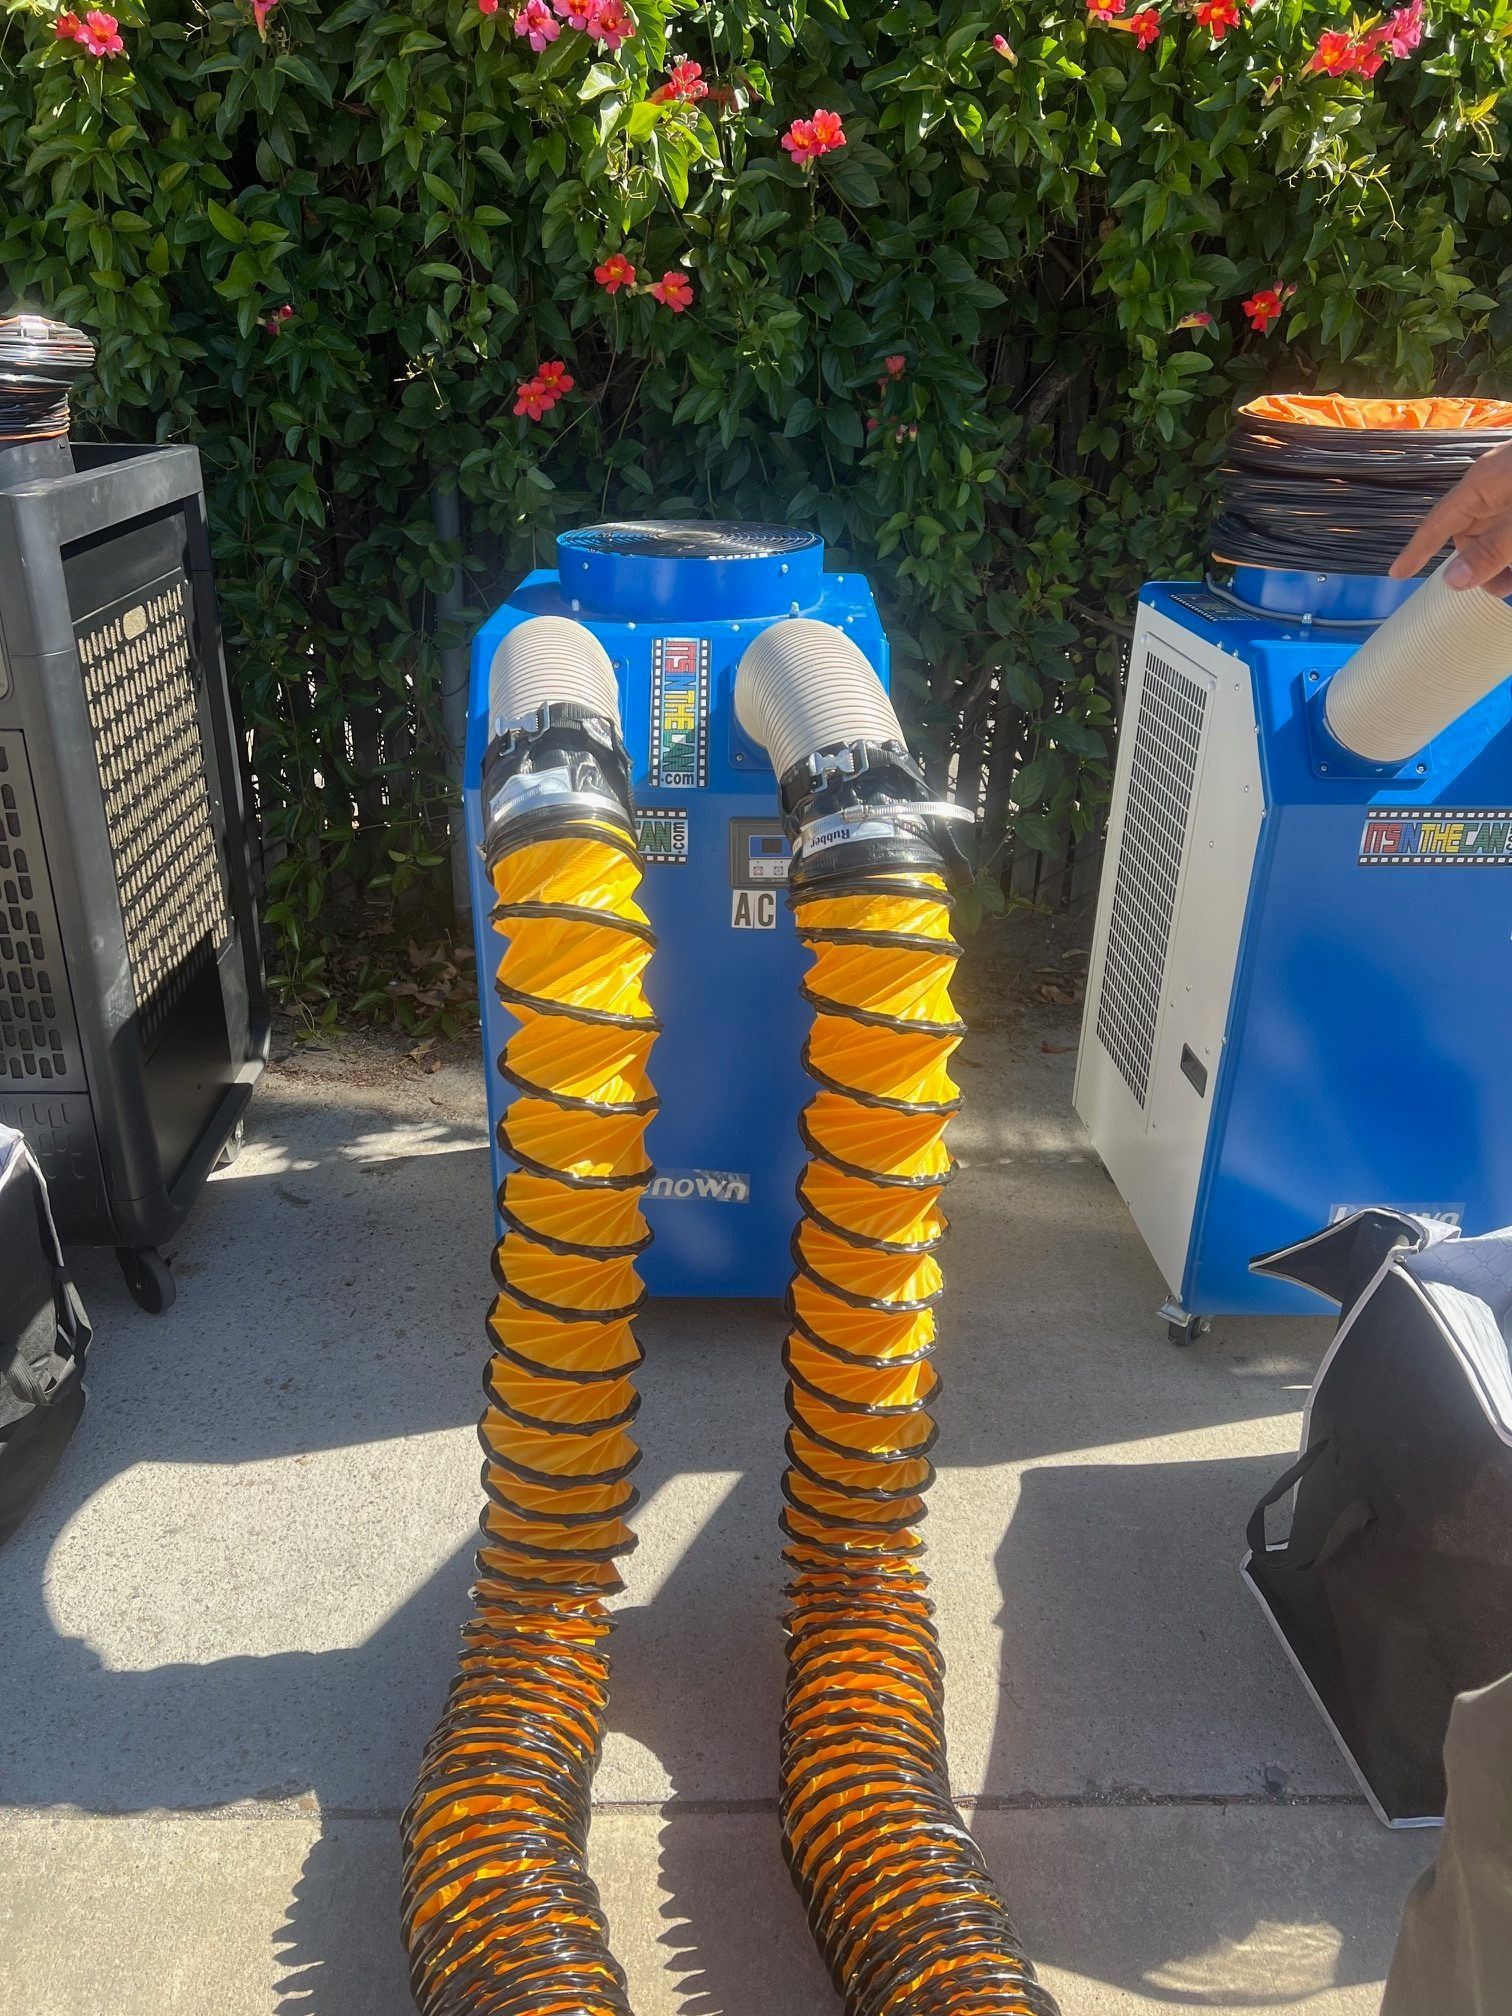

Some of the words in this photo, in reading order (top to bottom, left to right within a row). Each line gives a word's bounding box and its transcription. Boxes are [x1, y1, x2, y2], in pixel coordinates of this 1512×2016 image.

[661, 773, 695, 785] .com
[635, 820, 672, 852] AN
[673, 822, 685, 853] .com
[810, 829, 851, 848] Rubber
[733, 892, 774, 927] AC
[640, 1178, 747, 1200] nown
